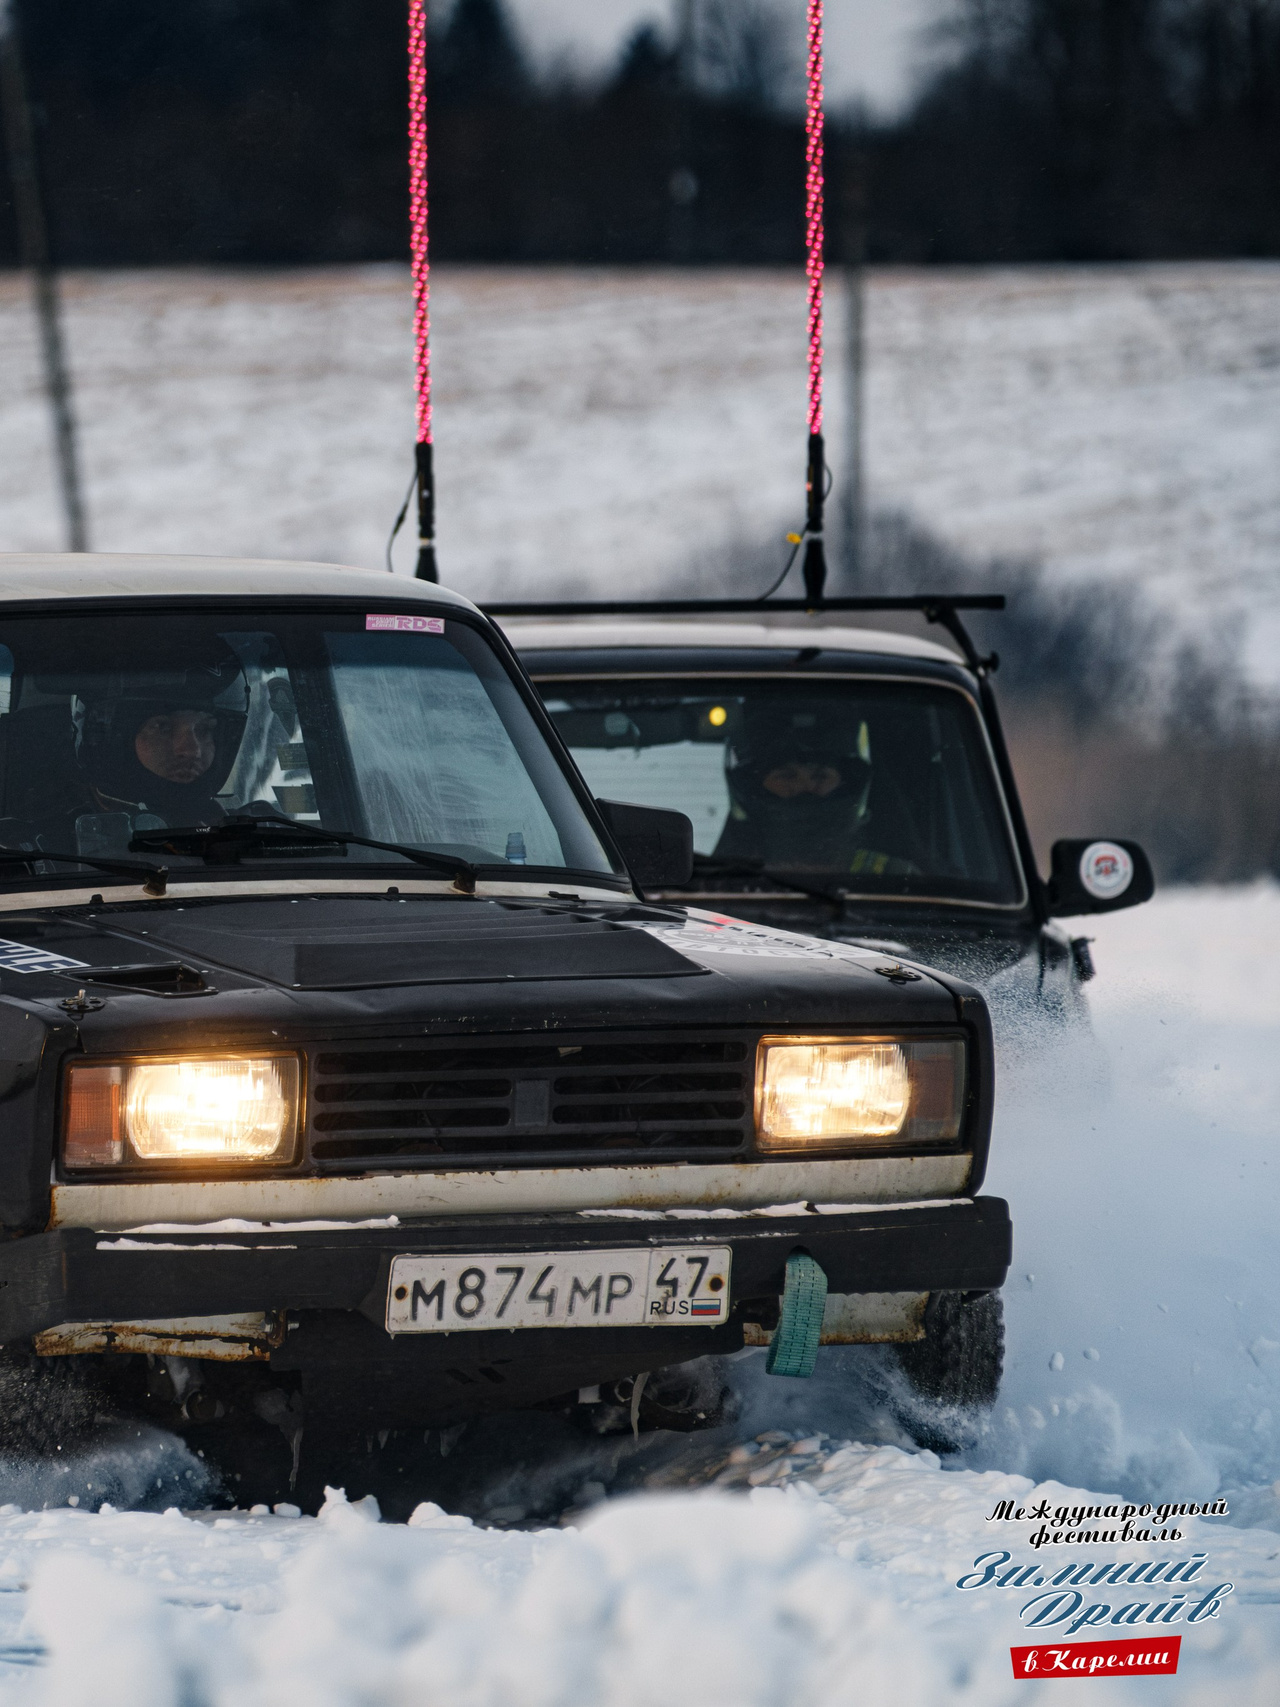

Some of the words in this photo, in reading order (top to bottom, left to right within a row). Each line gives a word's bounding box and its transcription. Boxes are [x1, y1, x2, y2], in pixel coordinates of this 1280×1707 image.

[396, 616, 442, 632] RDS
[656, 1257, 710, 1298] 47
[650, 1300, 689, 1315] RUS
